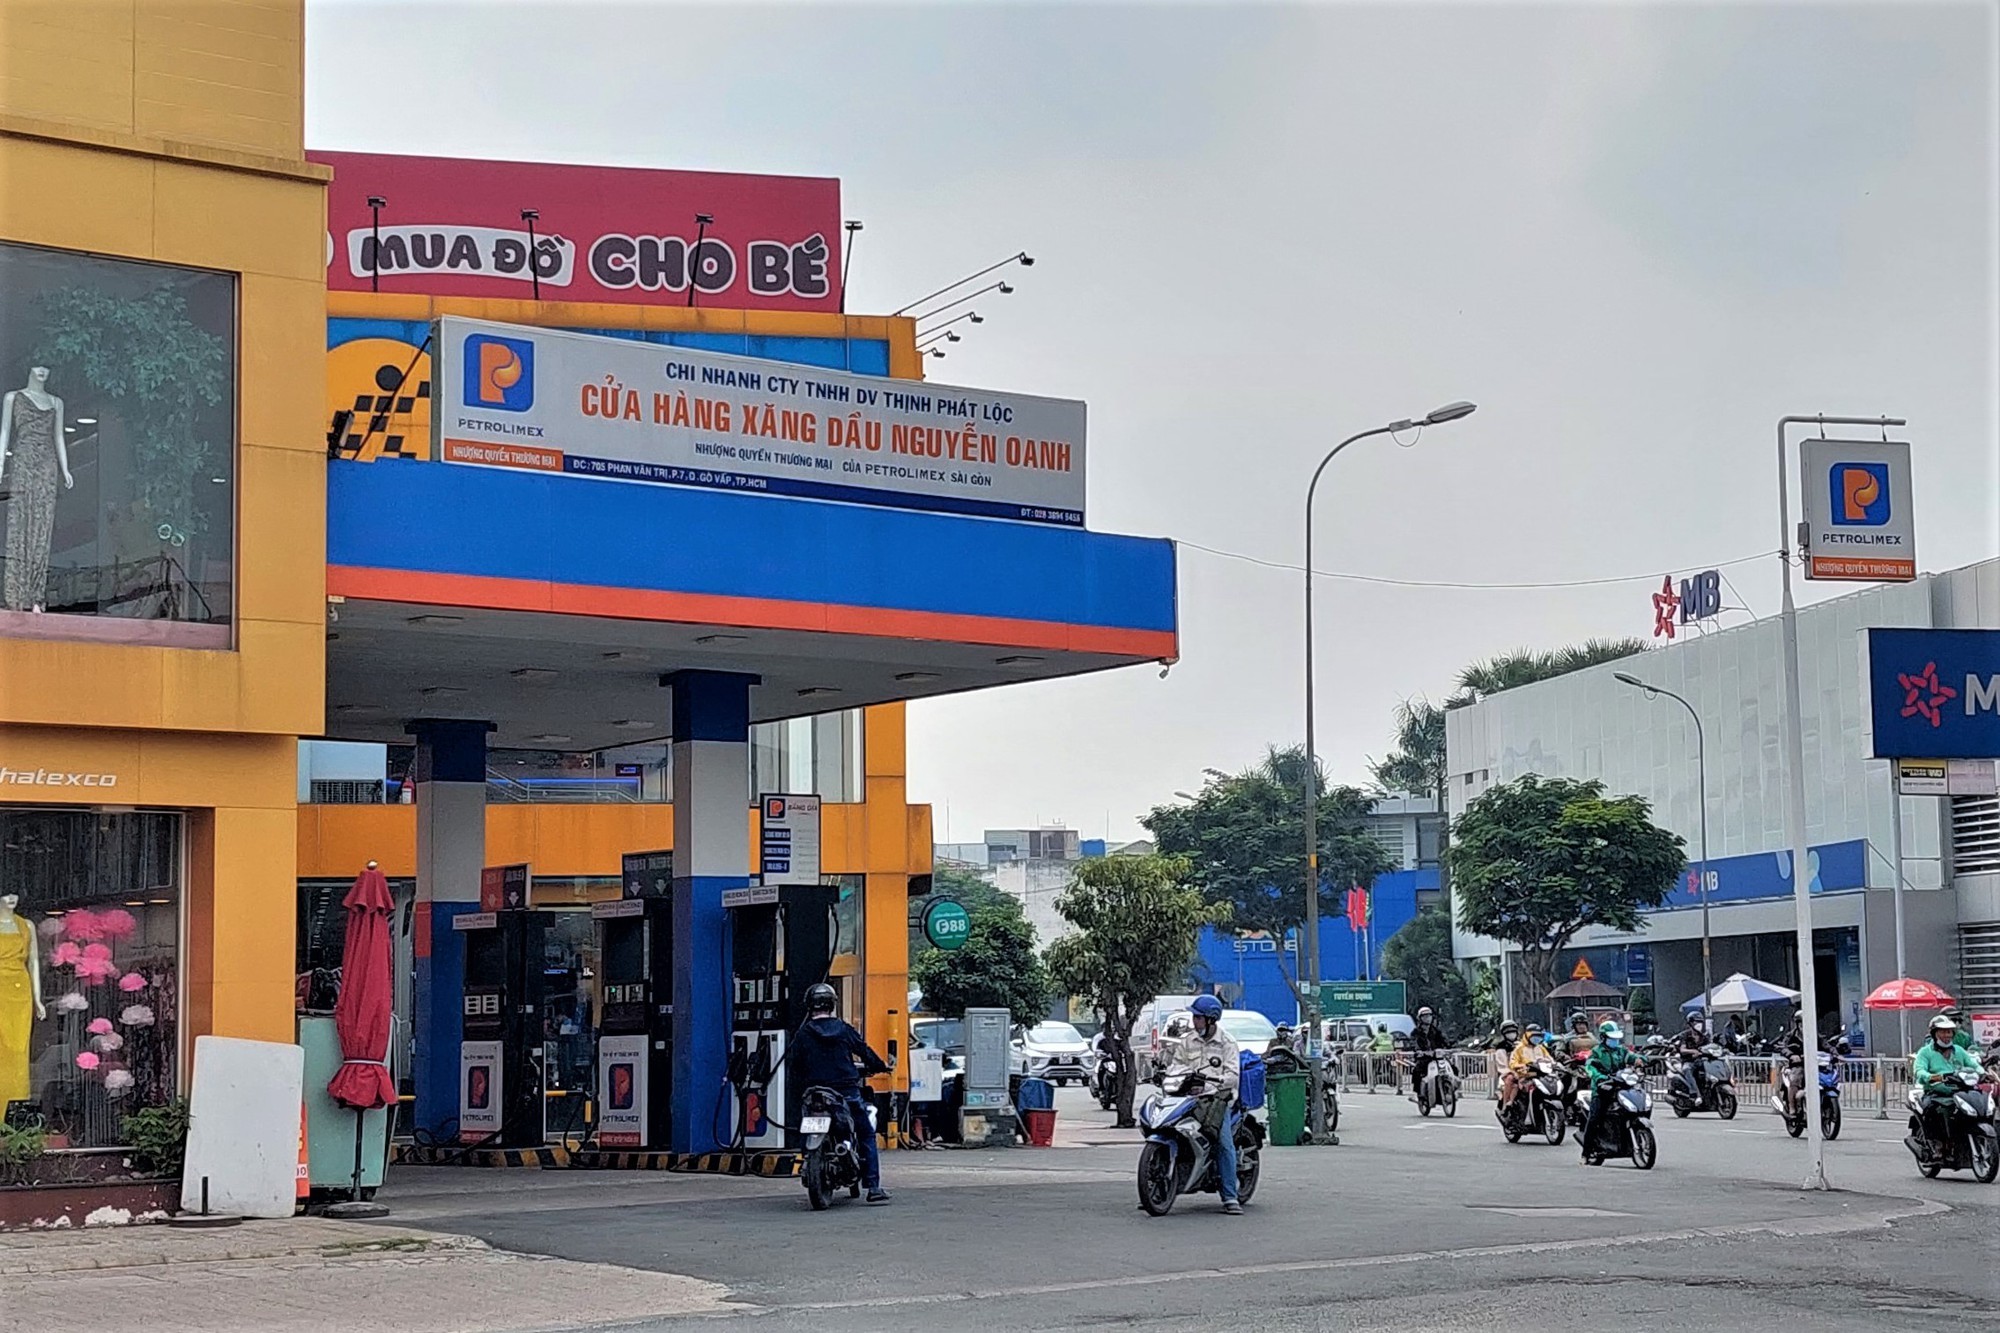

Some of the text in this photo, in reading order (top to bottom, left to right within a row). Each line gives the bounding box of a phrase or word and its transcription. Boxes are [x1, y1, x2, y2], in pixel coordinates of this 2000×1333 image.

[360, 233, 566, 278] MUA ĐỒ
[590, 234, 829, 295] CHO BÉ
[666, 362, 1013, 424] CHI NHANH CTY TNHH DV THỊNH PHÁT LỘC
[458, 418, 544, 437] PETROLIMEX
[581, 374, 1071, 472] CỬA HÀNG XĂNG DẦU NGUYỄN OANH
[607, 463, 632, 475] PHAN
[633, 464, 652, 477] VĂN
[695, 442, 736, 460] NHƯỢNG
[775, 452, 813, 467] THƯƠNG
[815, 457, 833, 471] MẠI
[843, 459, 862, 474] CỦA
[865, 464, 946, 482] PETROLIMEX
[950, 469, 968, 484] SÀI
[970, 471, 992, 486] GÒN
[1822, 533, 1902, 545] PETROLIMEX
[1680, 570, 1721, 624] MB
[935, 918, 967, 935] F88
